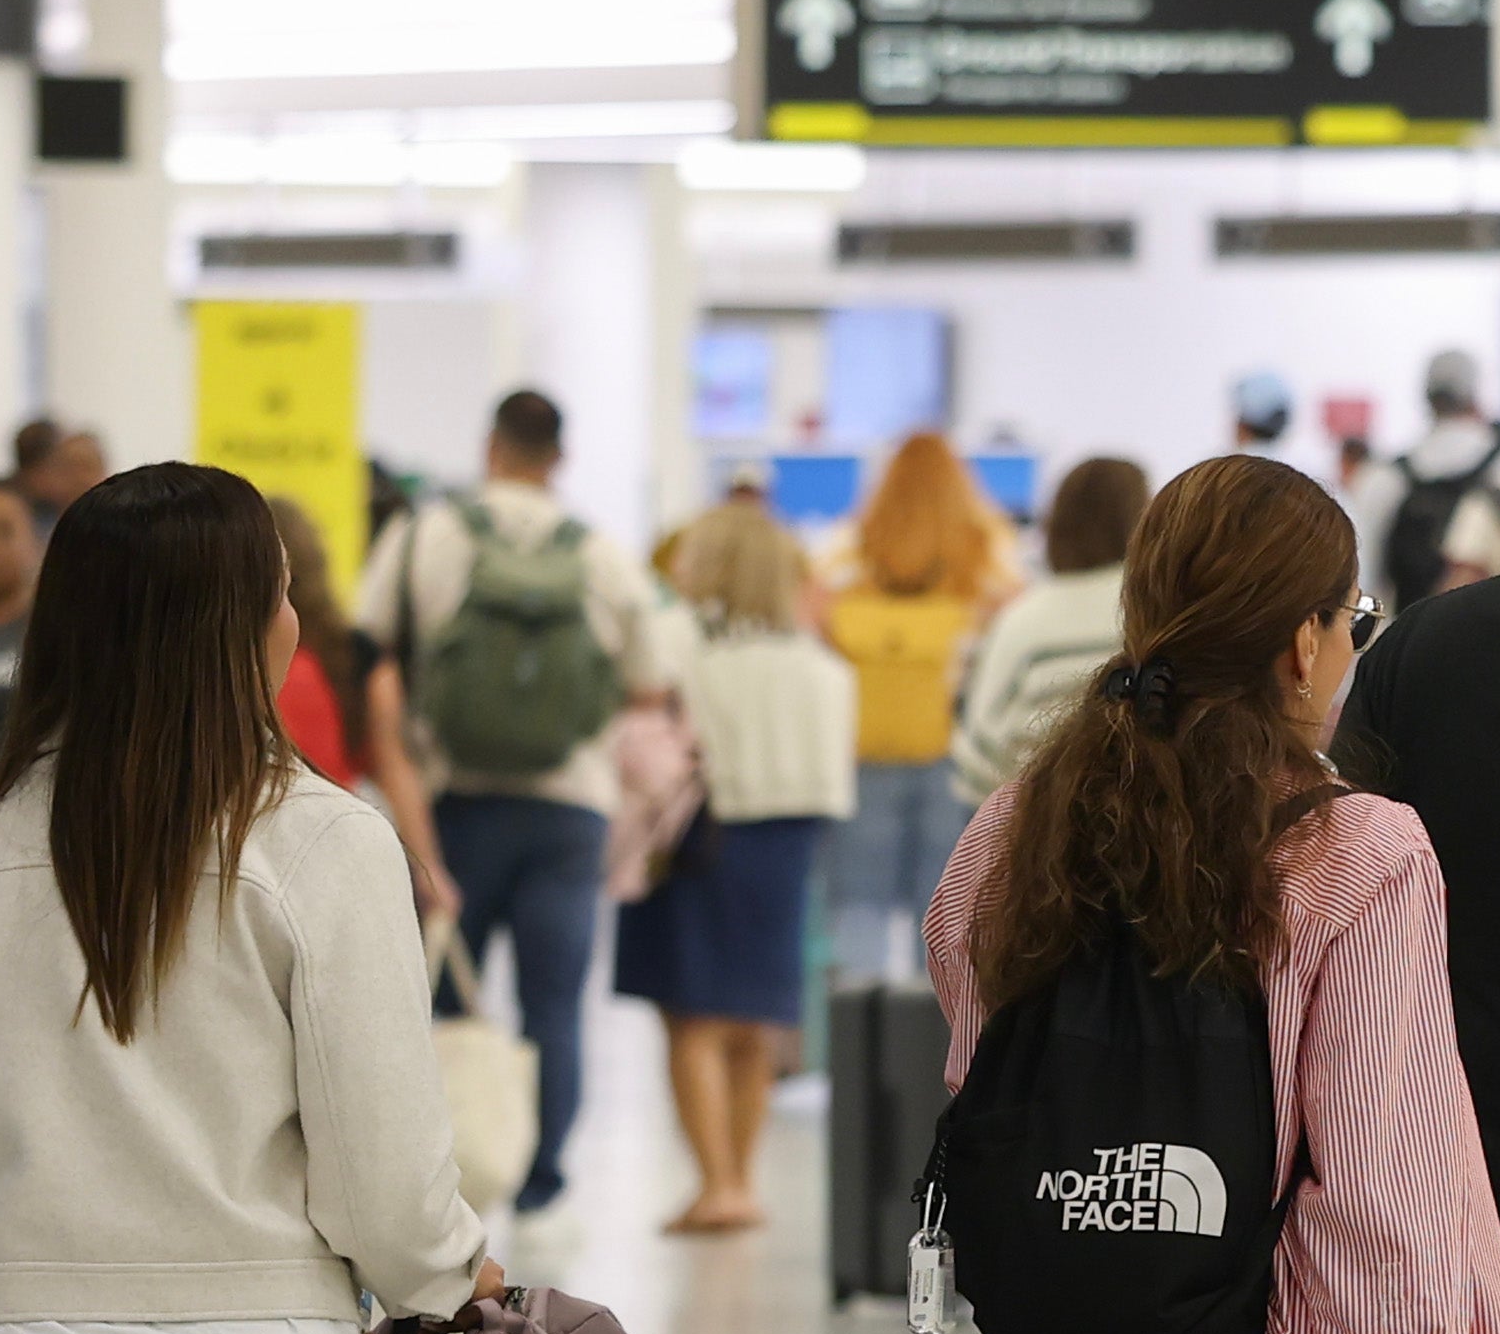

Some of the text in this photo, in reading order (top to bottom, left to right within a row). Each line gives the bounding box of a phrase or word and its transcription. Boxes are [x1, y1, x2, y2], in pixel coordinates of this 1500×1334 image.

[1092, 1142, 1164, 1176] THE
[1035, 1169, 1161, 1202] NORTH
[1061, 1199, 1159, 1233] FACE
